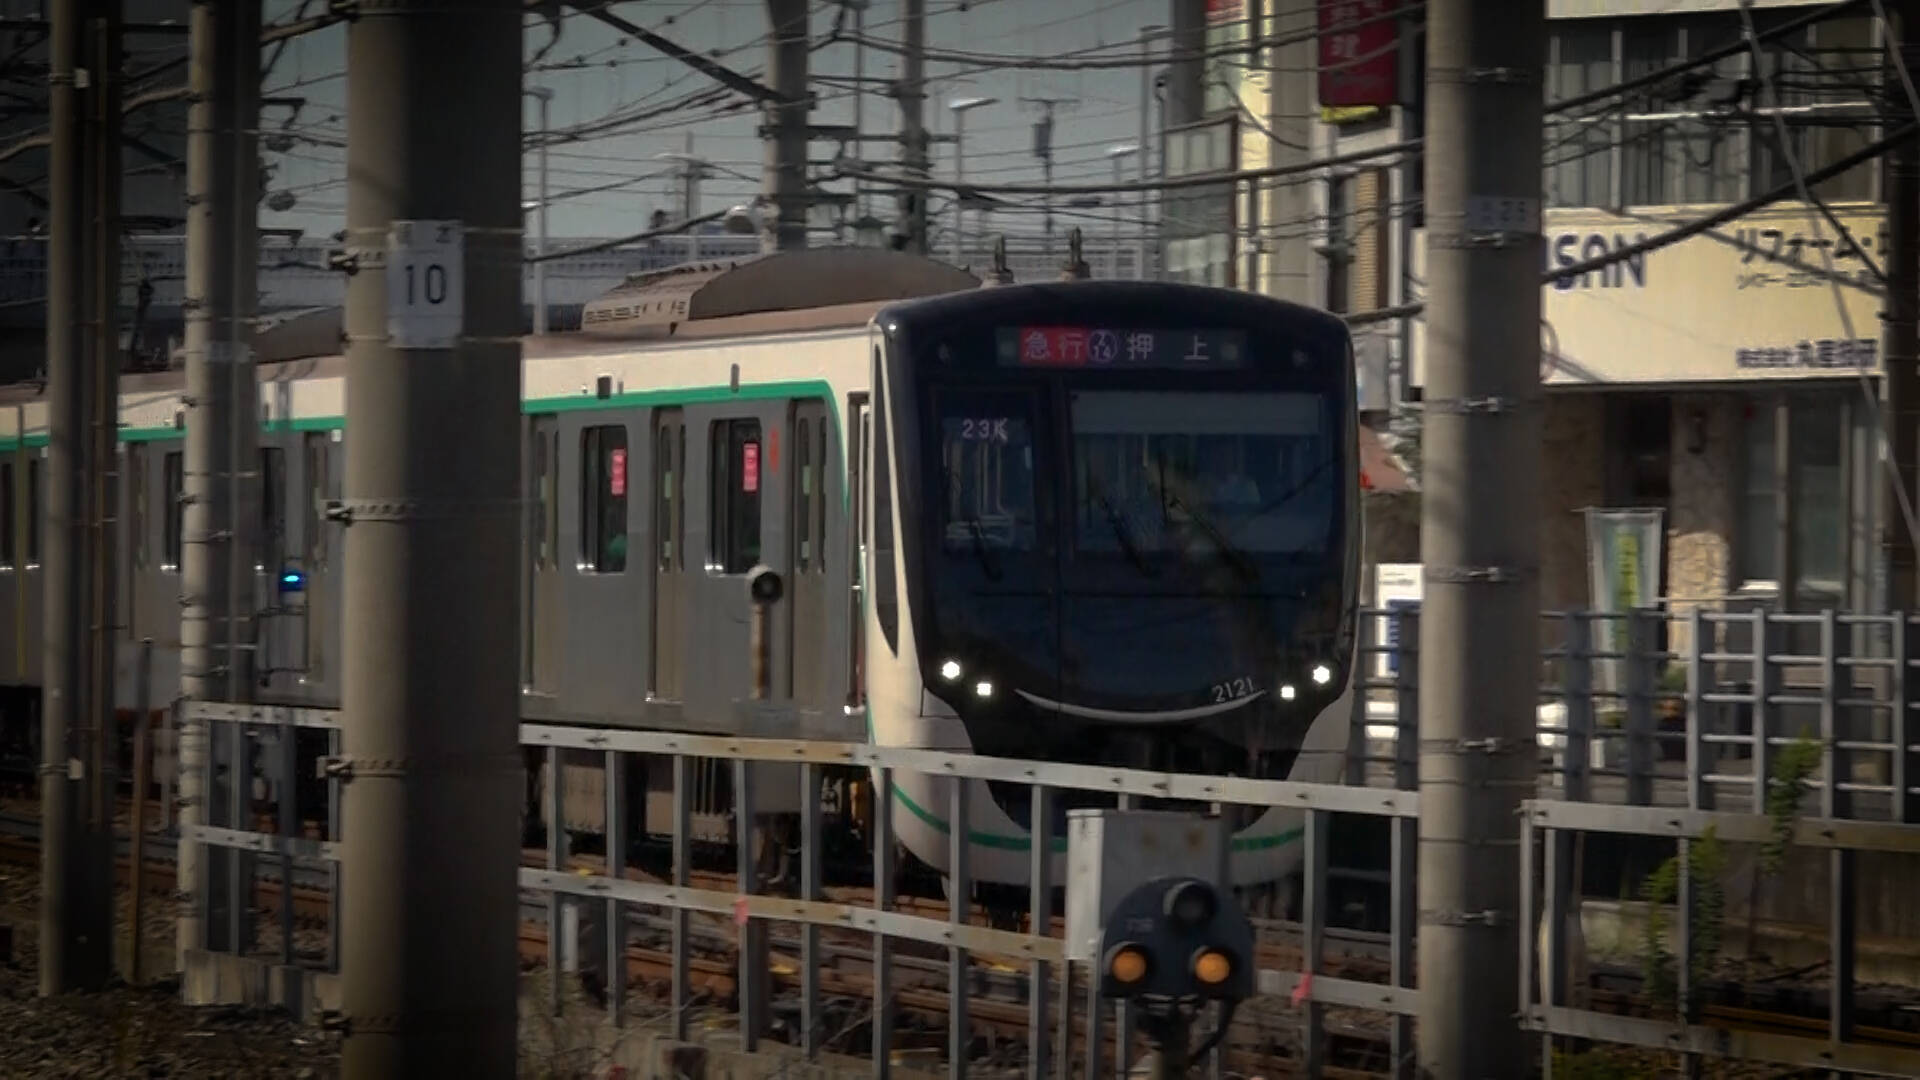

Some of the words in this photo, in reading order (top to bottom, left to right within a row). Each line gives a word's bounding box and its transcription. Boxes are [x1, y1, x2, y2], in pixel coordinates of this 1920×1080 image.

[405, 263, 447, 305] 10
[1024, 331, 1083, 360] 急行
[962, 417, 1008, 441] 23K
[1212, 677, 1254, 703] 2121
